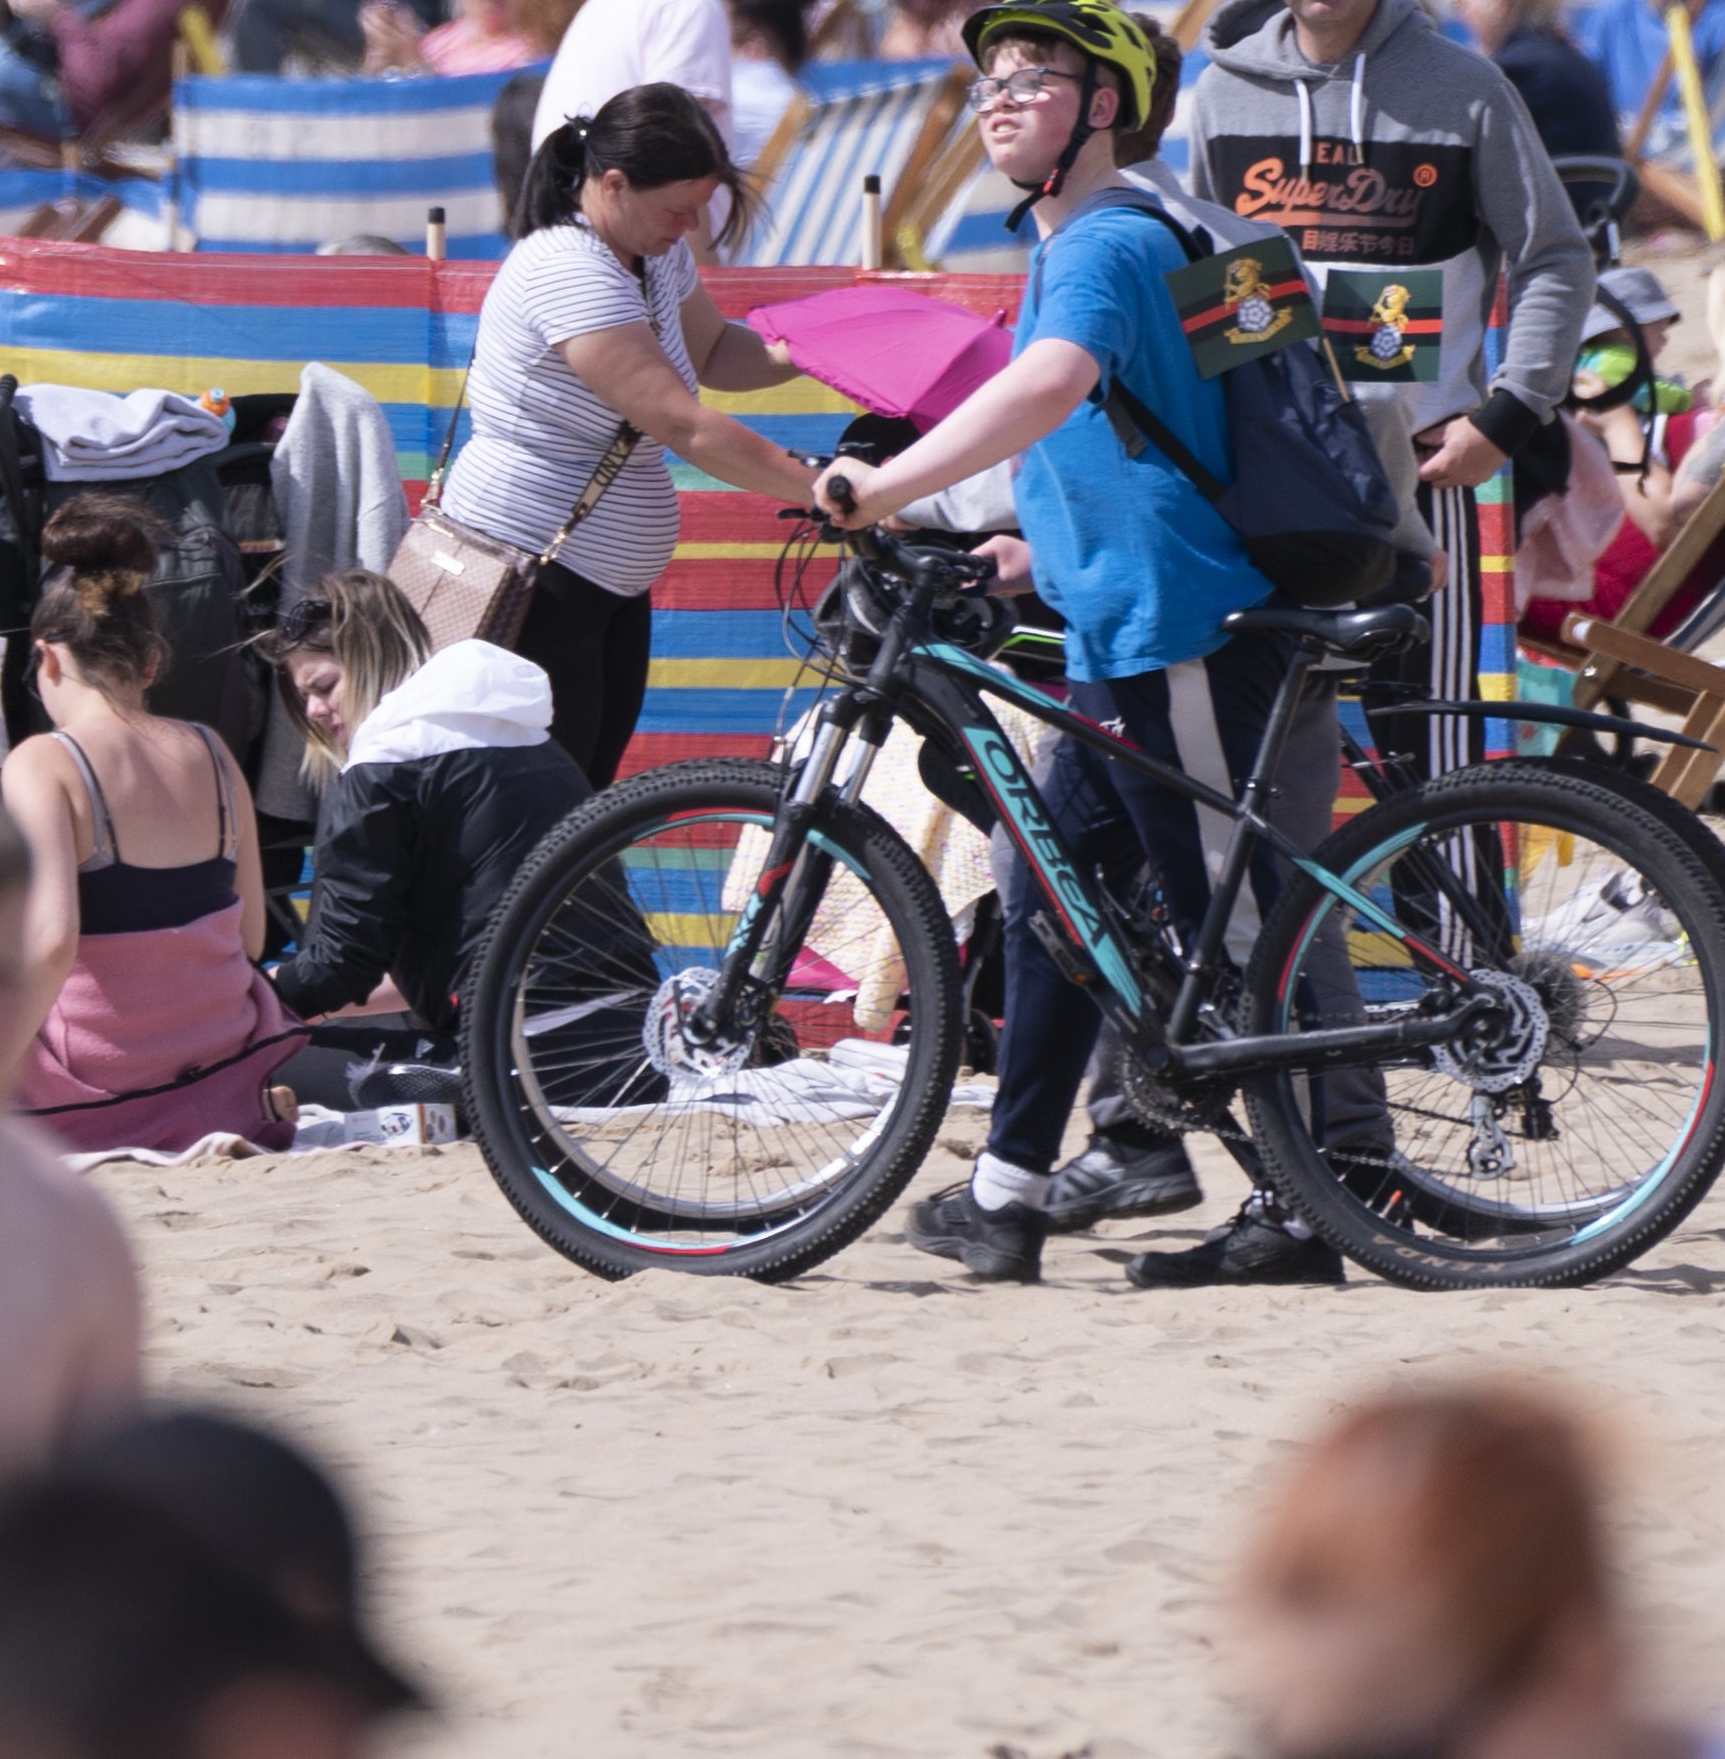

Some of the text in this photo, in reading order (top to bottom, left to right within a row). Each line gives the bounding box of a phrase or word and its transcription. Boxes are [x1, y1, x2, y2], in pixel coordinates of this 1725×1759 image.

[1310, 141, 1363, 166] EAL
[983, 738, 1108, 946] ORBEA
[1372, 1232, 1508, 1274] KENDA
